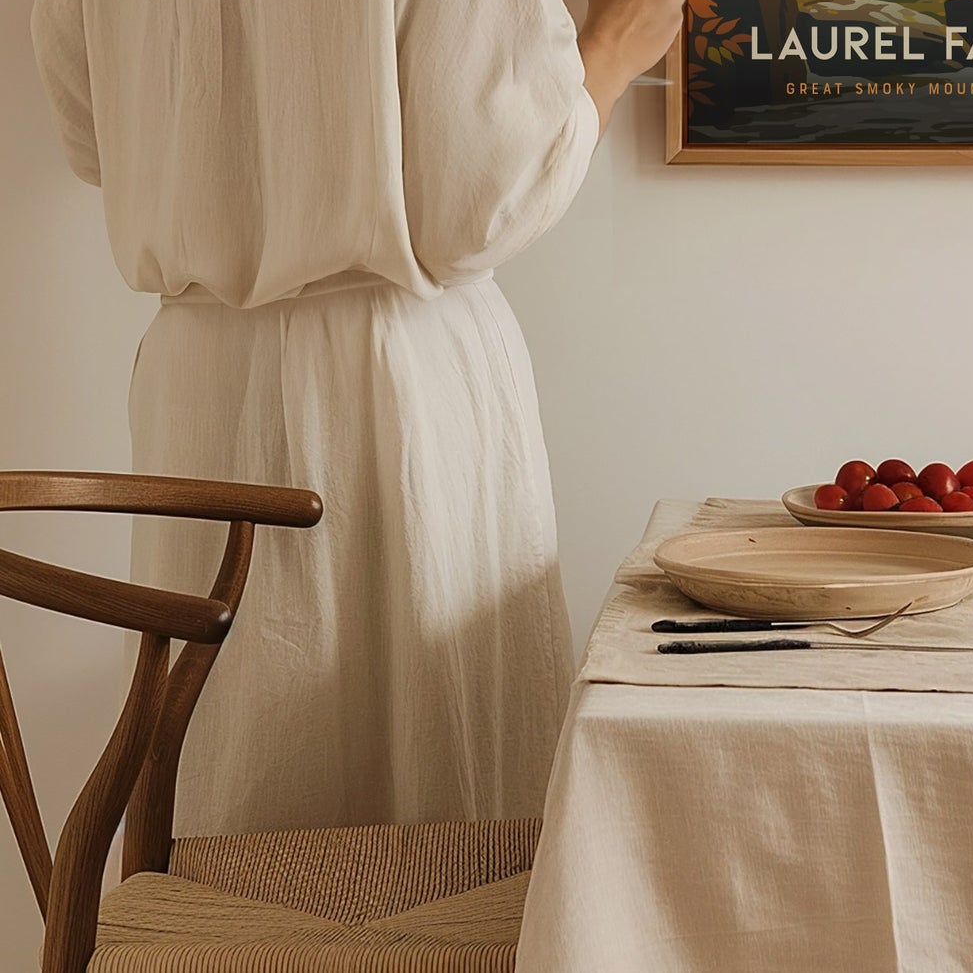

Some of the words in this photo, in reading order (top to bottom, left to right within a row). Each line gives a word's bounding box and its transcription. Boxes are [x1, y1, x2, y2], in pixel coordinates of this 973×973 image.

[750, 25, 925, 61] LAUREL
[785, 82, 842, 95] GREAT
[854, 82, 916, 95] SMOKY
